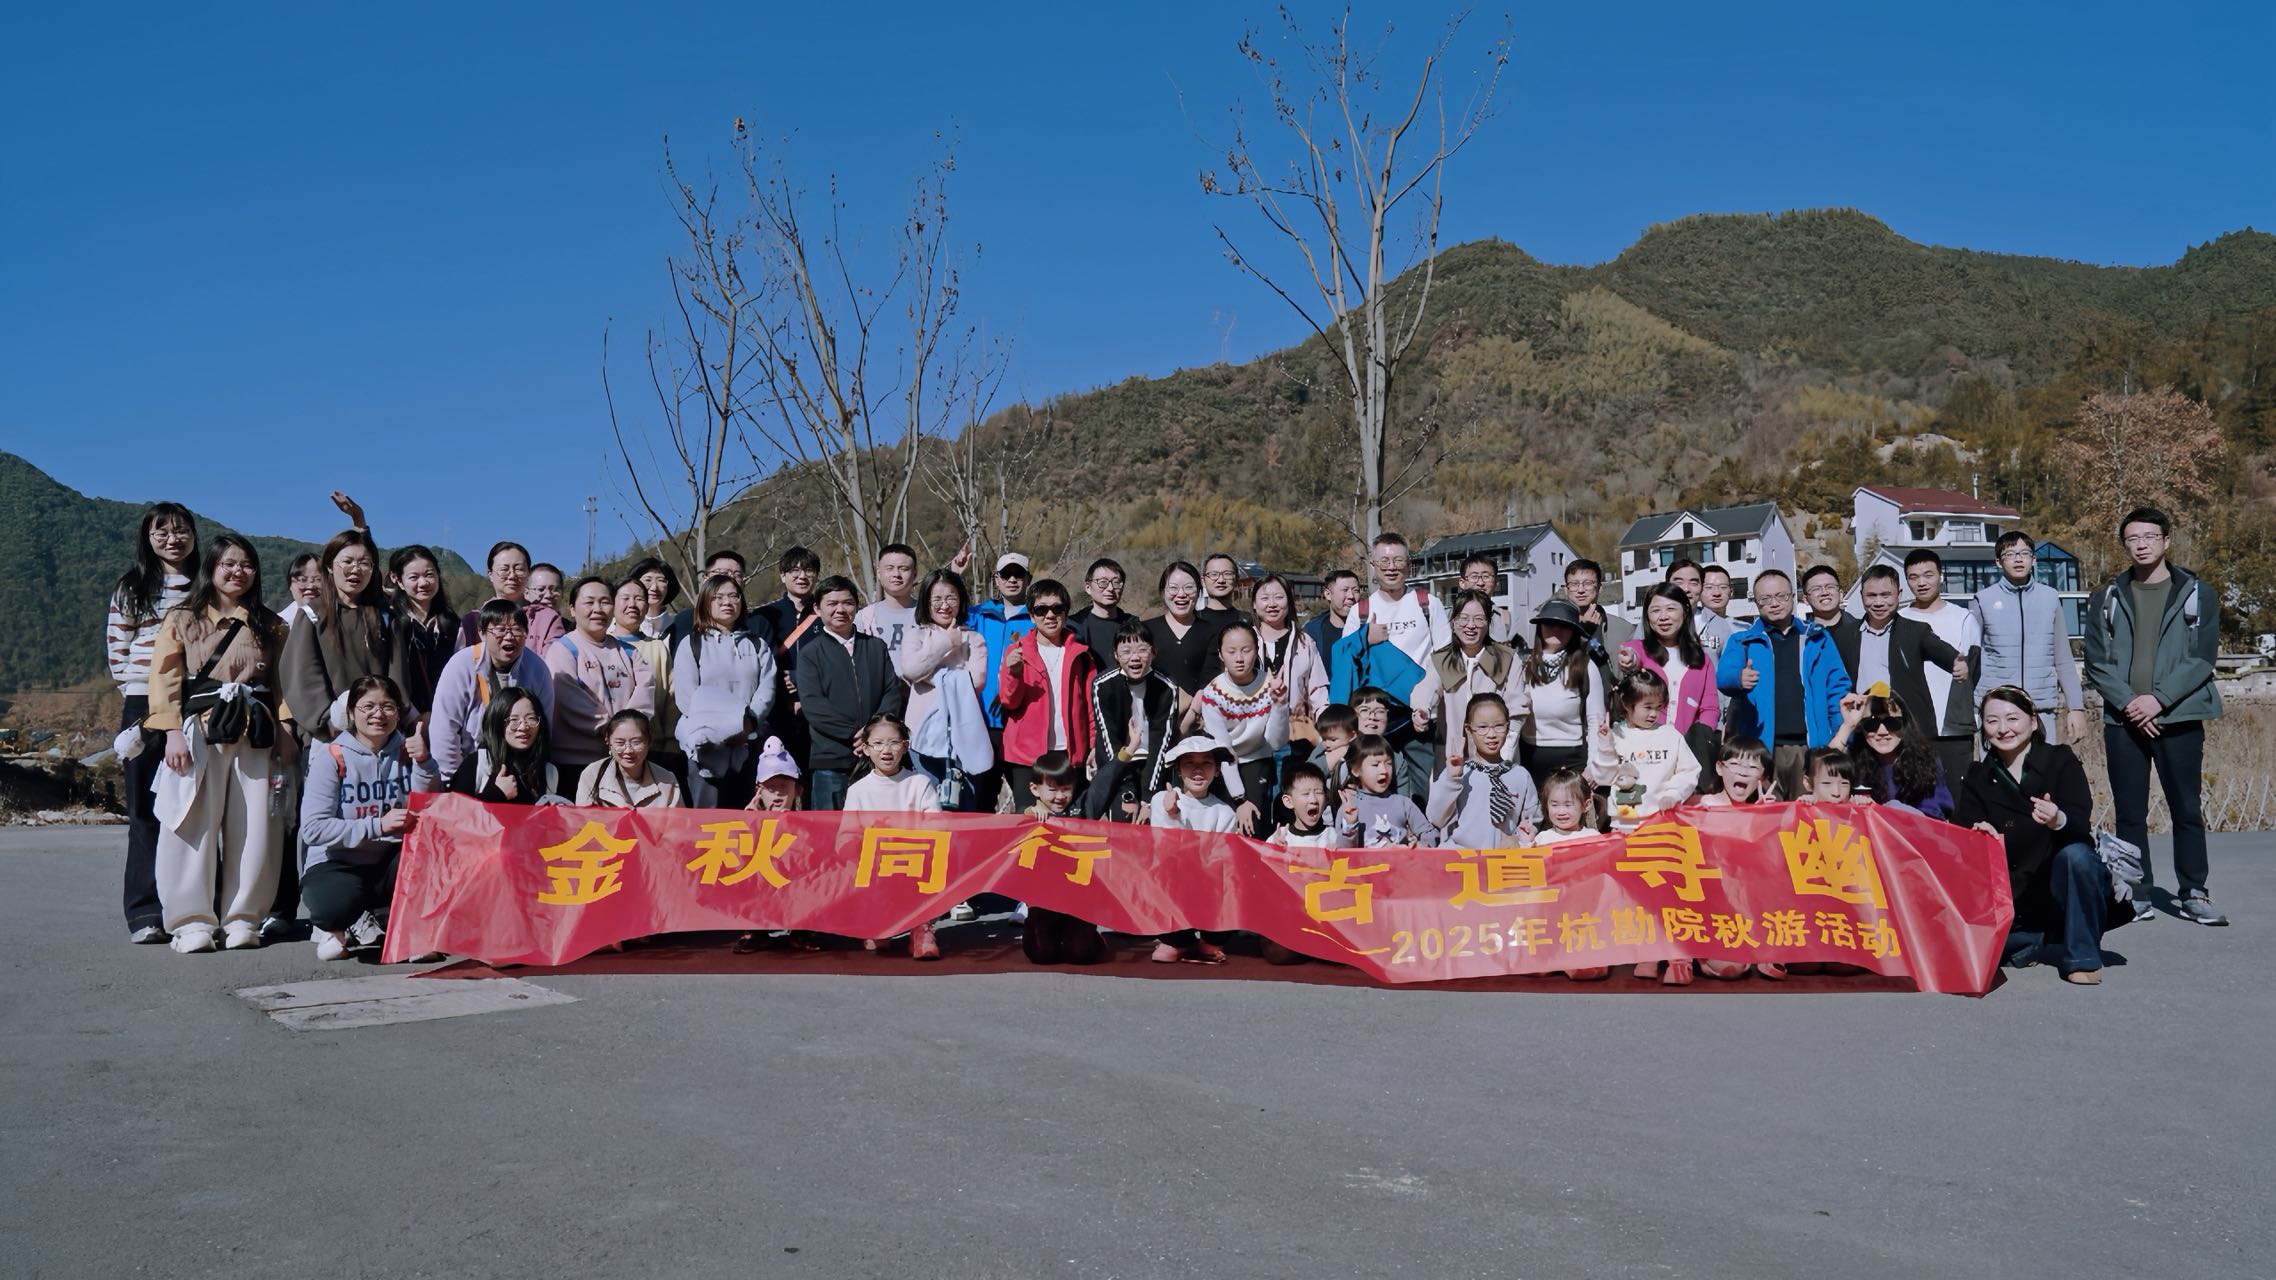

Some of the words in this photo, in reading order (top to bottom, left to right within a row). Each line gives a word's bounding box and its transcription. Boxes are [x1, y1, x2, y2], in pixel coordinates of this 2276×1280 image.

[537, 819, 1112, 904] 金秋同行
[1288, 818, 1889, 925] 古道寻幽
